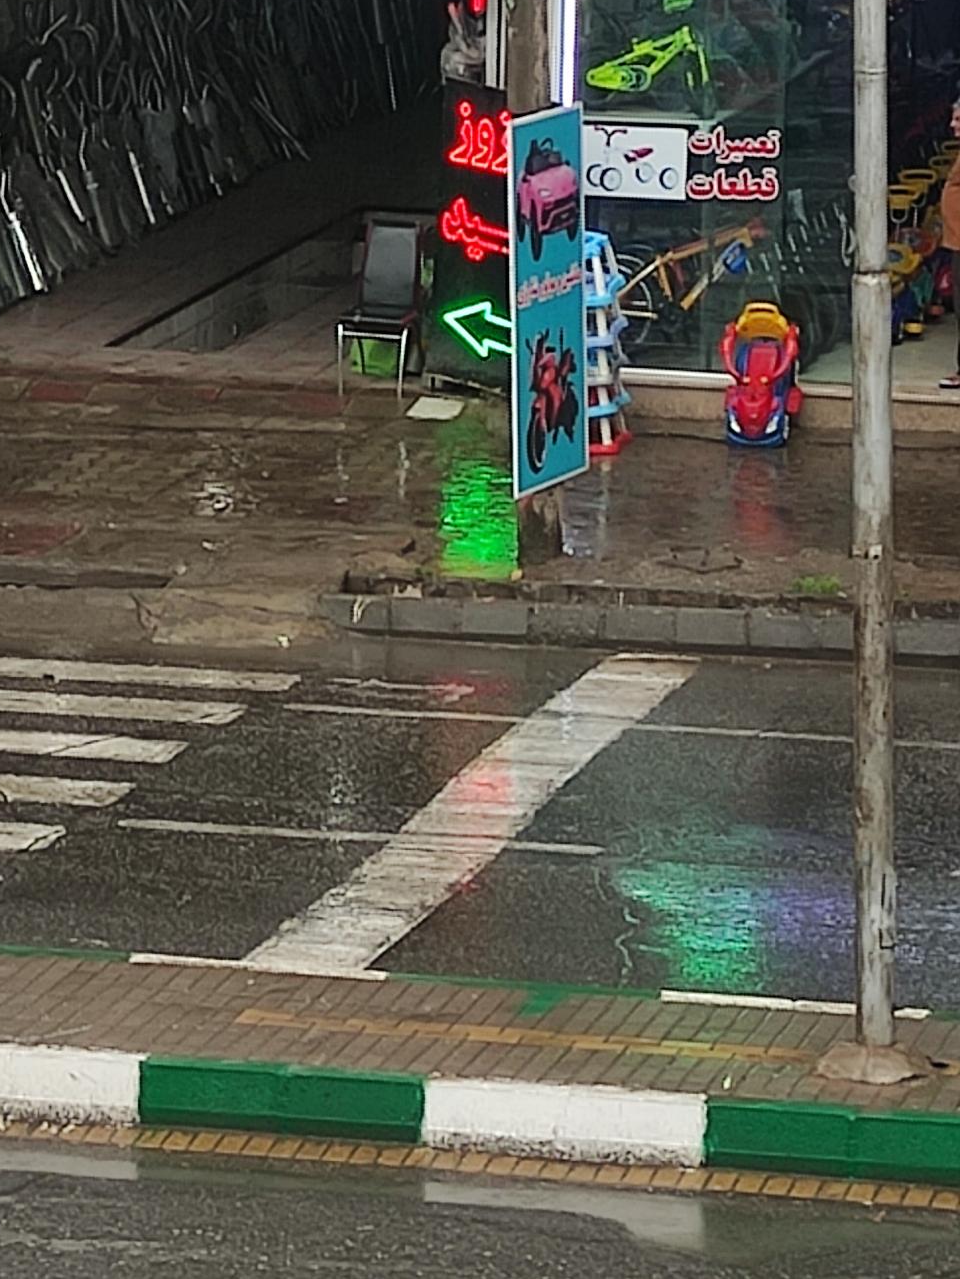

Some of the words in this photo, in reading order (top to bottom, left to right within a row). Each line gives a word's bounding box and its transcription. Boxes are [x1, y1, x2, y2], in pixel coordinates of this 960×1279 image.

[448, 100, 510, 175] زوز
[688, 124, 782, 164] تعمیرات
[686, 166, 779, 201] قطعات
